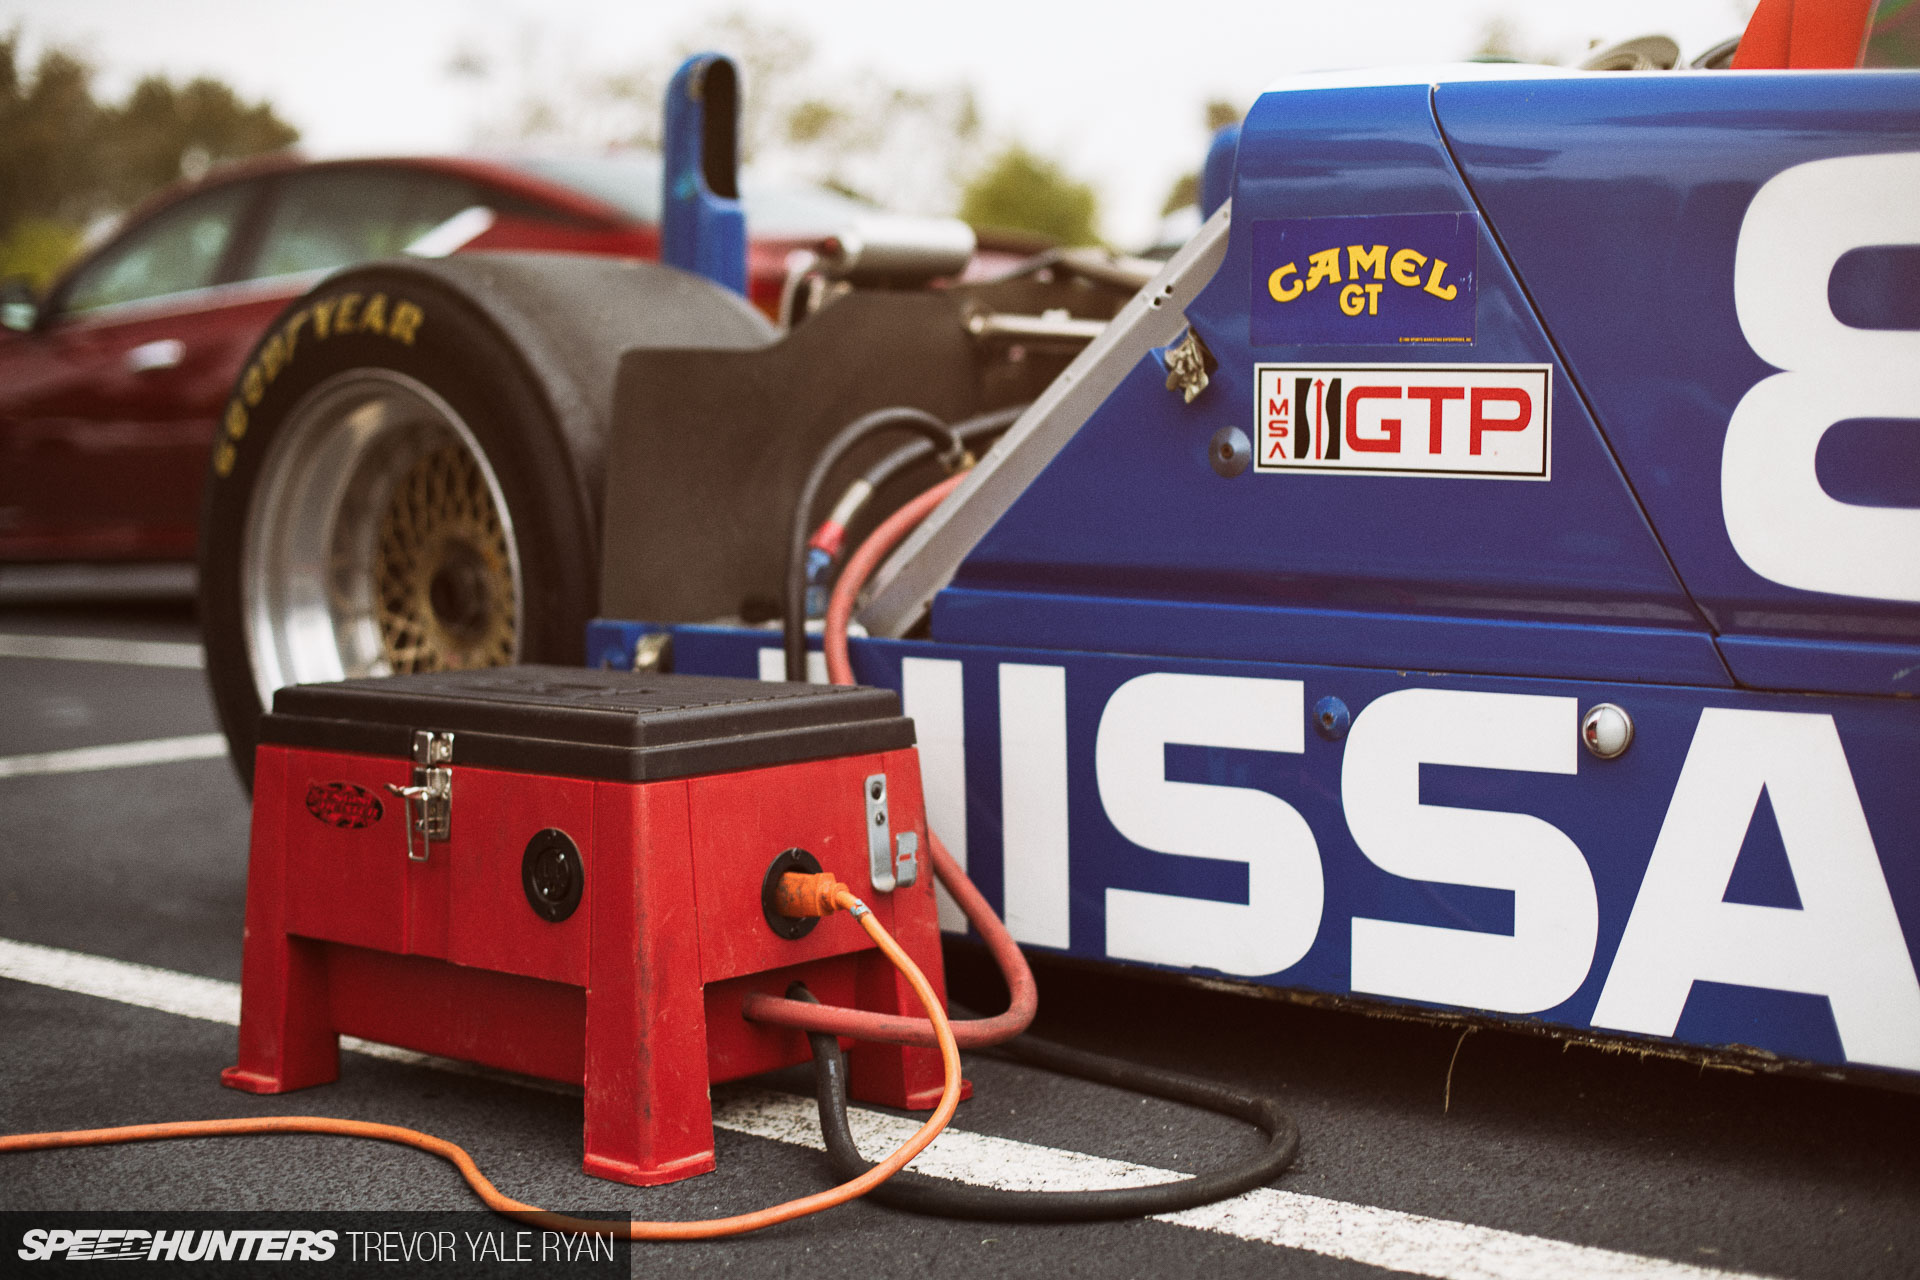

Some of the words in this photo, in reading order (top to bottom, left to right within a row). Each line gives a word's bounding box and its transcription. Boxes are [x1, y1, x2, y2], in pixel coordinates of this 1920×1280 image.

[1268, 244, 1458, 302] CAMEL
[1339, 283, 1383, 316] GT
[1721, 151, 1920, 601] 8
[1268, 377, 1289, 459] IMSA
[1345, 386, 1532, 456] GTP
